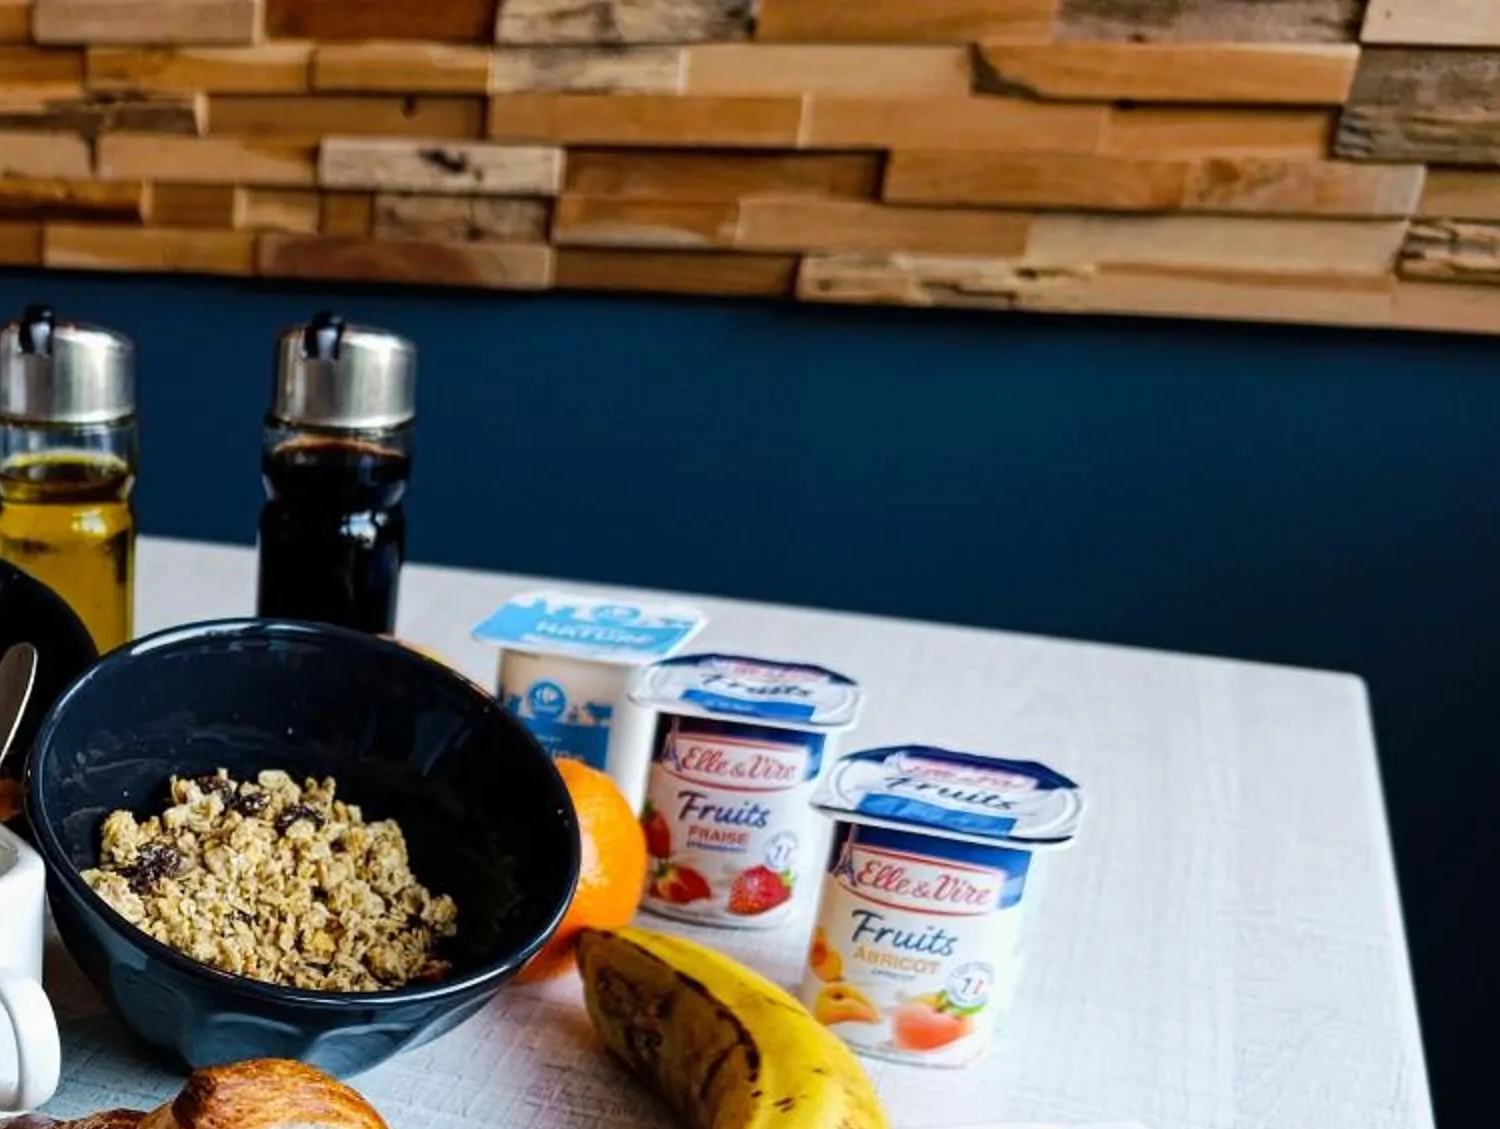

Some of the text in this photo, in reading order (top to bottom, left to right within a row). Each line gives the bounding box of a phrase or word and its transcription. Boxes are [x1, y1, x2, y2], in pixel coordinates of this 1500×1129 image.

[681, 747, 797, 780] Elle & Vire
[677, 790, 772, 829] Fruits
[883, 776, 1018, 810] Fruits
[688, 826, 749, 845] FRAISE
[856, 859, 994, 906] Elle & Vire
[851, 909, 959, 956] Fruits
[853, 947, 943, 976] ABRICOT
